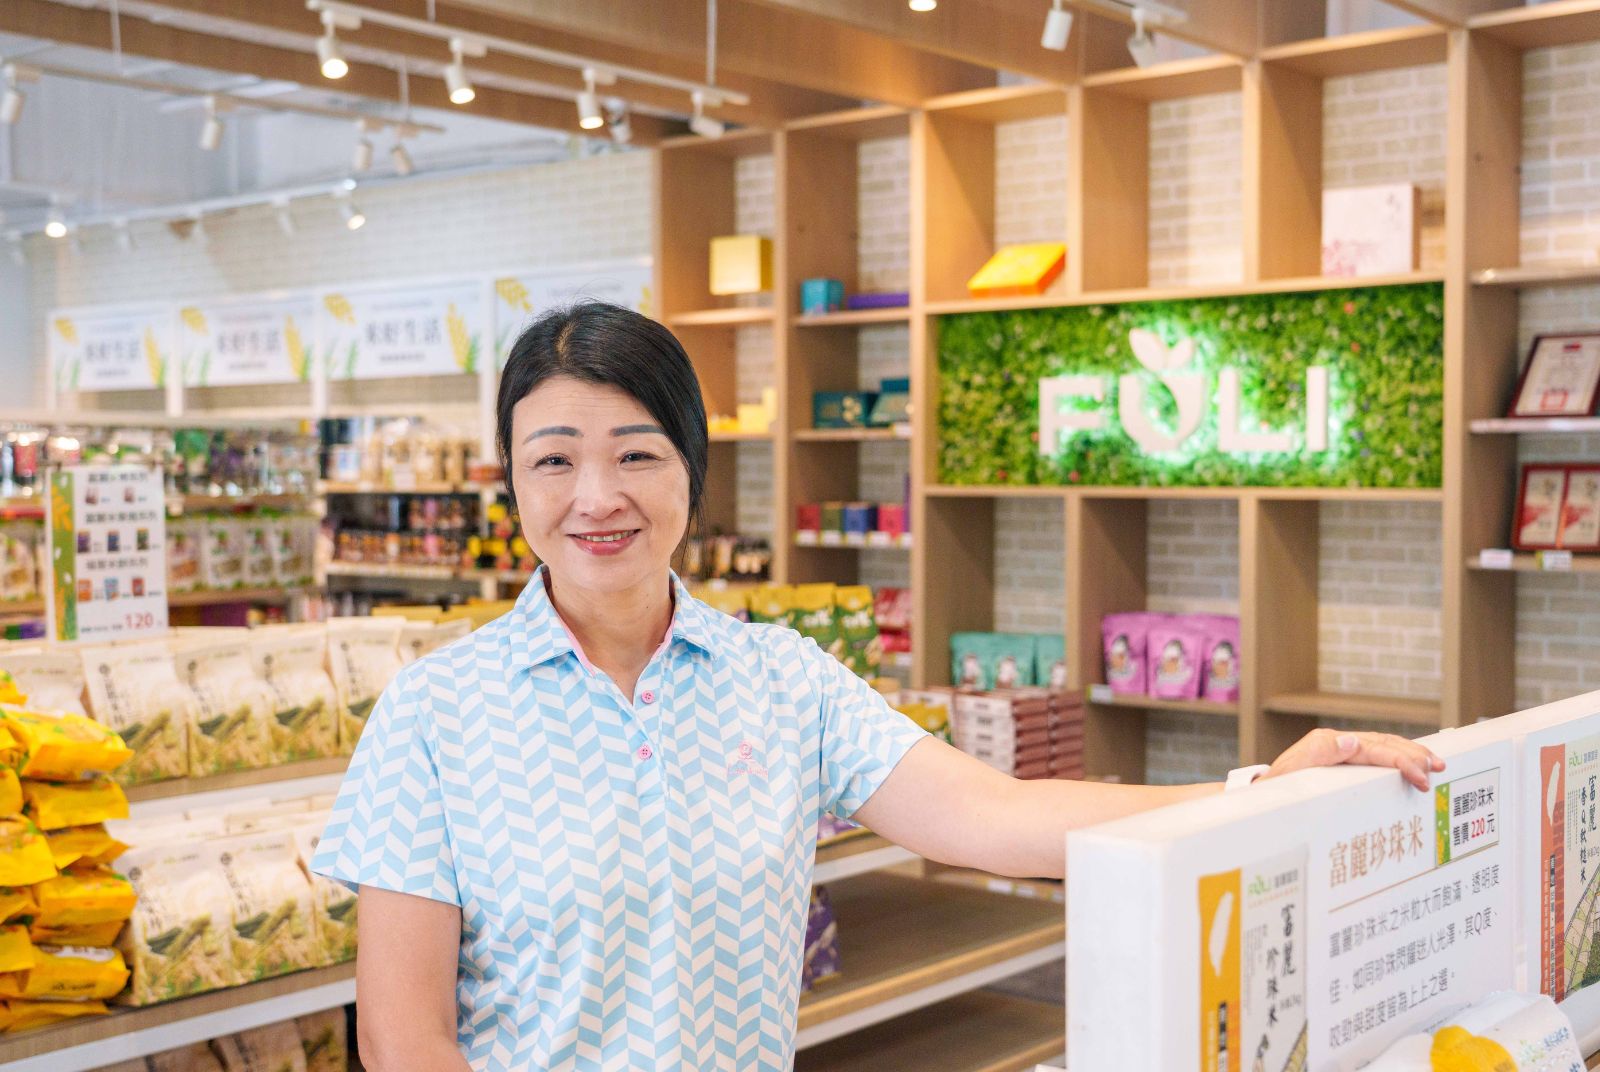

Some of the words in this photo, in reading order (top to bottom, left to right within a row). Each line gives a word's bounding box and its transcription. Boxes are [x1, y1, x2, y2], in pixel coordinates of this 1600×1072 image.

[1037, 350, 1329, 456] FULI
[125, 612, 154, 629] 120
[1471, 818, 1485, 838] 220
[1486, 813, 1495, 835] 元
[1329, 814, 1424, 888] 富麗珍珠米
